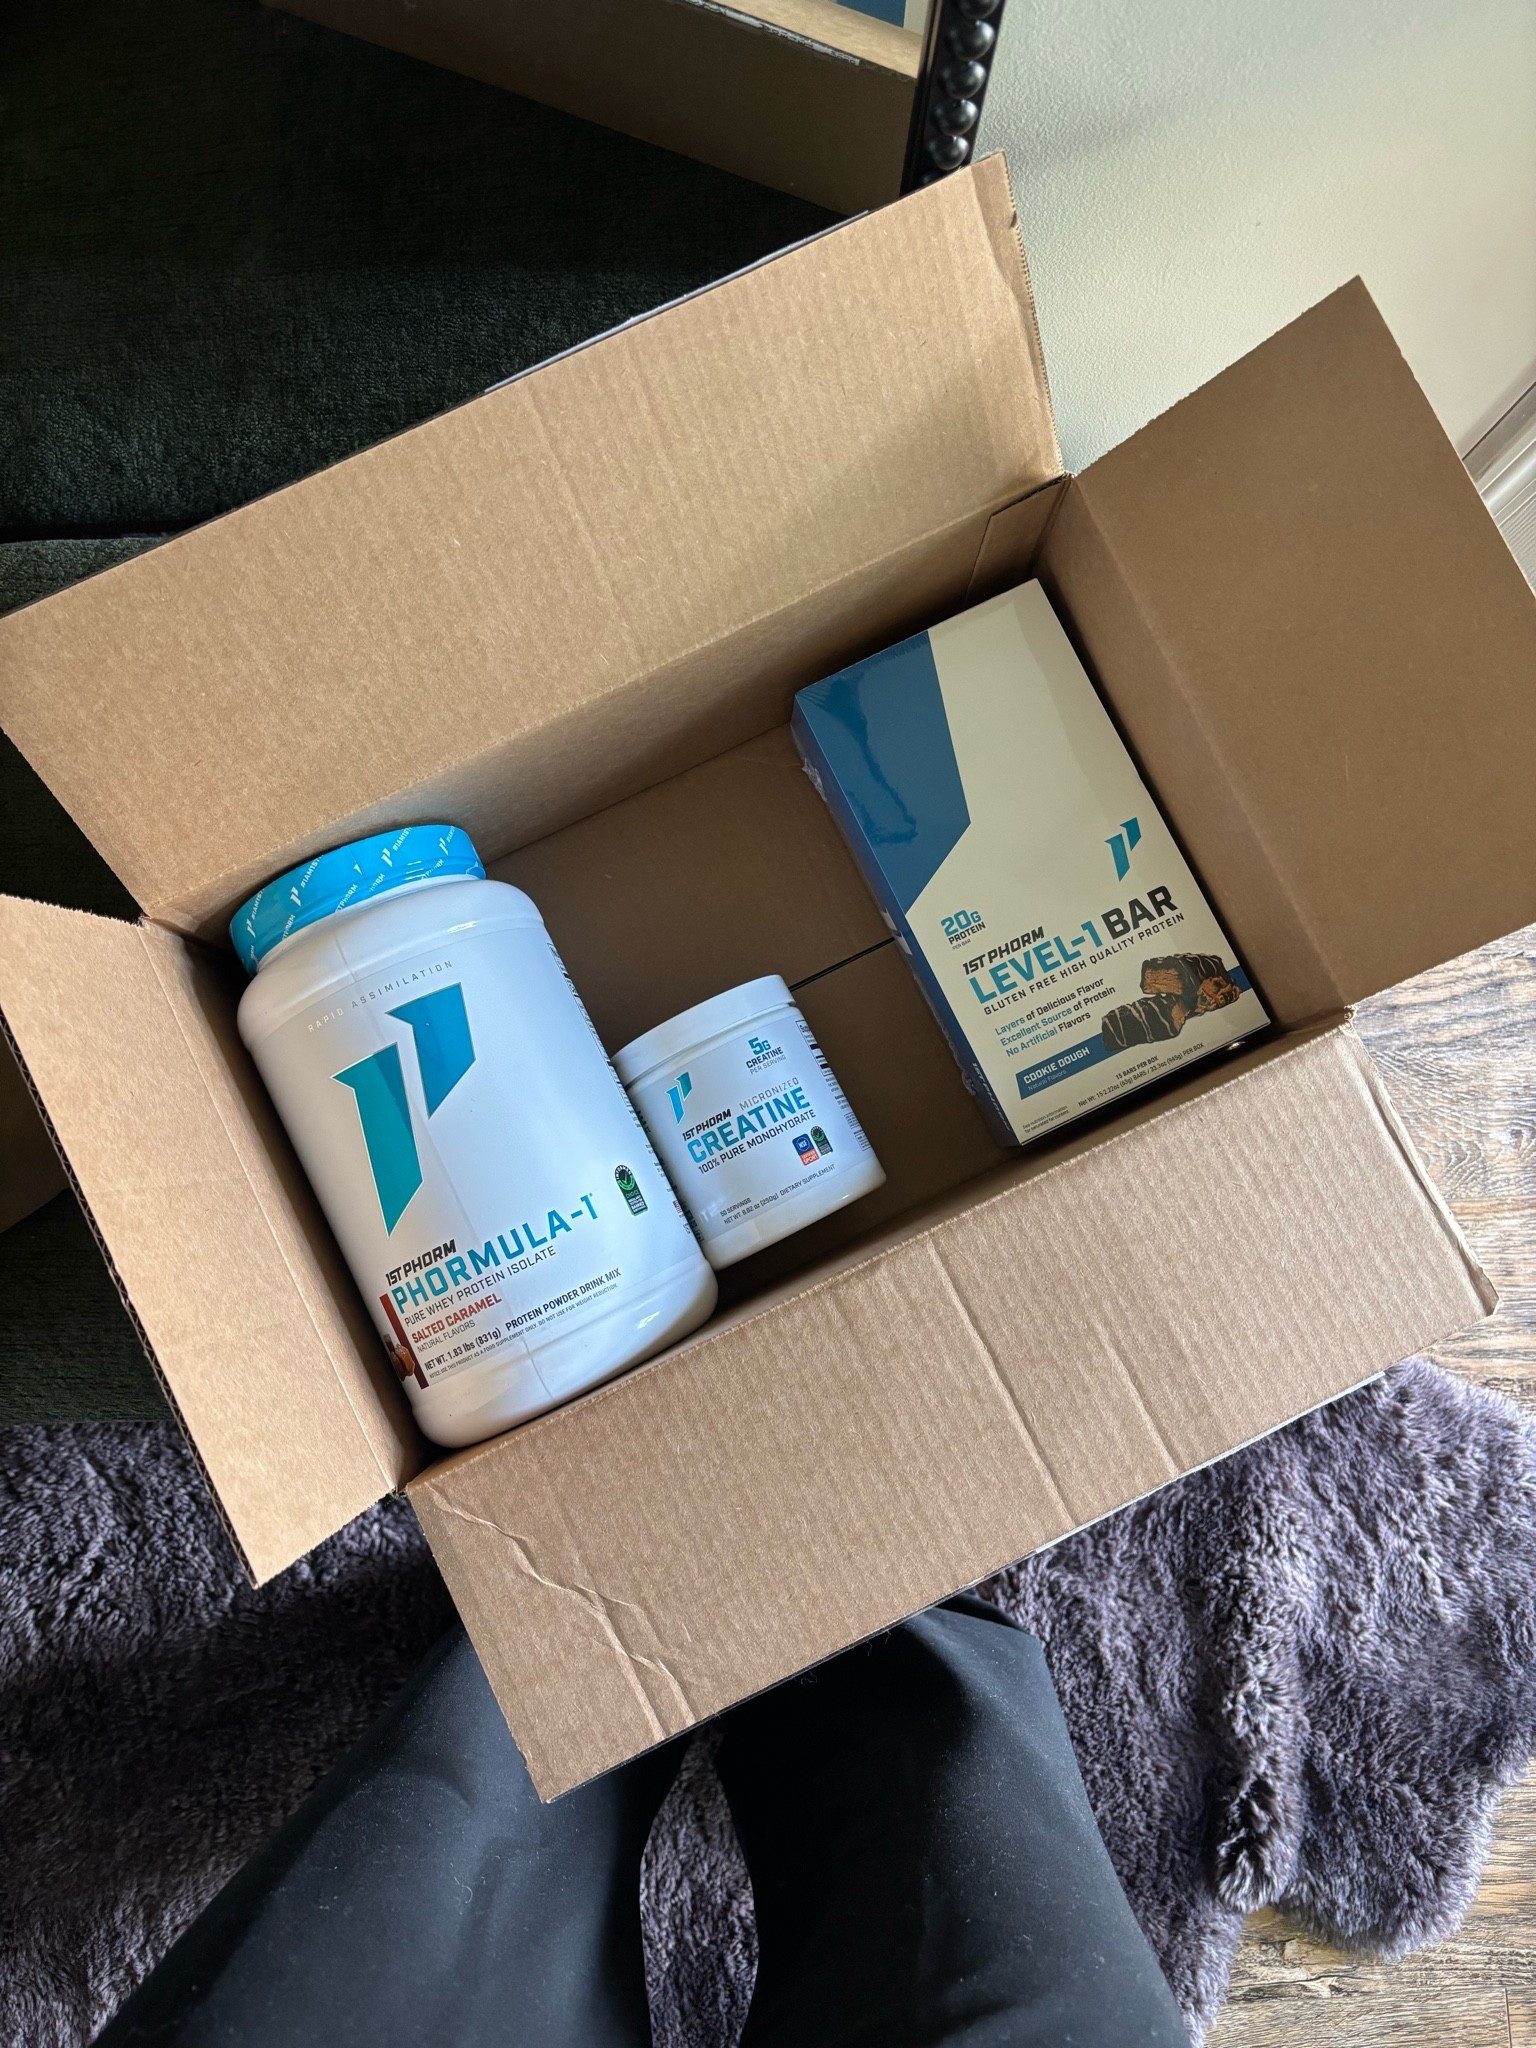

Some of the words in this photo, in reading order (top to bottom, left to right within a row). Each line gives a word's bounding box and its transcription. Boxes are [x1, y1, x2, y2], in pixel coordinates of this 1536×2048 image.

[941, 910, 982, 936] 20G
[949, 922, 986, 945] PROTEIN
[969, 920, 1103, 1004] LEVEL-1
[1101, 884, 1178, 940] BAR
[984, 989, 1027, 1016] GLUTEN
[1029, 974, 1058, 993] FREE
[1060, 960, 1087, 978] HIGH
[1089, 936, 1134, 964] QUALITY
[1138, 913, 1185, 941] PROTEIN
[307, 1007, 344, 1033] RAPID
[351, 960, 453, 1009] ASSIMILATION
[995, 1016, 1026, 1036] Layers
[1025, 1010, 1037, 1021] of
[1037, 991, 1077, 1016] Delicious
[1077, 978, 1105, 996] Flavor
[1001, 1022, 1041, 1046] Excellent
[1041, 1007, 1073, 1027] Source
[1073, 1001, 1084, 1011] of
[1083, 986, 1116, 1006] Protein
[748, 1037, 771, 1056] 5G
[1006, 1046, 1019, 1057] No
[1019, 1027, 1058, 1050] Artificial
[1058, 1011, 1091, 1032] Flavors
[1183, 1047, 1194, 1056] PER
[1193, 1042, 1204, 1051] BOX
[746, 1047, 783, 1069] CREATINE
[750, 1065, 762, 1075] PER
[763, 1054, 786, 1069] SERVING
[1023, 1063, 1058, 1084] COOKIE
[1058, 1047, 1090, 1068] DOUGH
[1122, 1066, 1137, 1077] BARS
[1137, 1061, 1148, 1070] PER
[1147, 1056, 1159, 1065] BOX
[739, 1077, 799, 1111] MICRONIZED
[1028, 1078, 1048, 1091] Natural
[686, 1087, 810, 1164] CREATINE
[698, 1158, 720, 1174] 100%
[720, 1144, 747, 1163] PURE
[747, 1109, 816, 1149] MONOHYDRATE
[724, 1216, 734, 1224] NET
[780, 1181, 802, 1196] DIETARY
[802, 1164, 836, 1184] SUPPLEMENT
[727, 1197, 752, 1213] SERVINGS
[391, 1195, 598, 1314] PHORMULA-1
[404, 1310, 427, 1327] PURE
[426, 1295, 454, 1316] WHEY
[456, 1270, 506, 1301] PROTEIN
[507, 1245, 557, 1276] ISOLATE
[411, 1320, 446, 1344] SALTED
[445, 1292, 502, 1327] CARAMEL
[417, 1335, 443, 1353] NATURAL
[442, 1319, 476, 1340] FLAVORS
[424, 1359, 435, 1371] NET
[435, 1355, 447, 1365] WT.
[447, 1346, 463, 1360] 1.83
[462, 1340, 475, 1352] lbs
[474, 1327, 503, 1348] (831g)
[505, 1307, 543, 1331] PROTEIN
[543, 1289, 580, 1312] POWDER
[579, 1276, 606, 1294] DRINK
[605, 1268, 621, 1281] MIX
